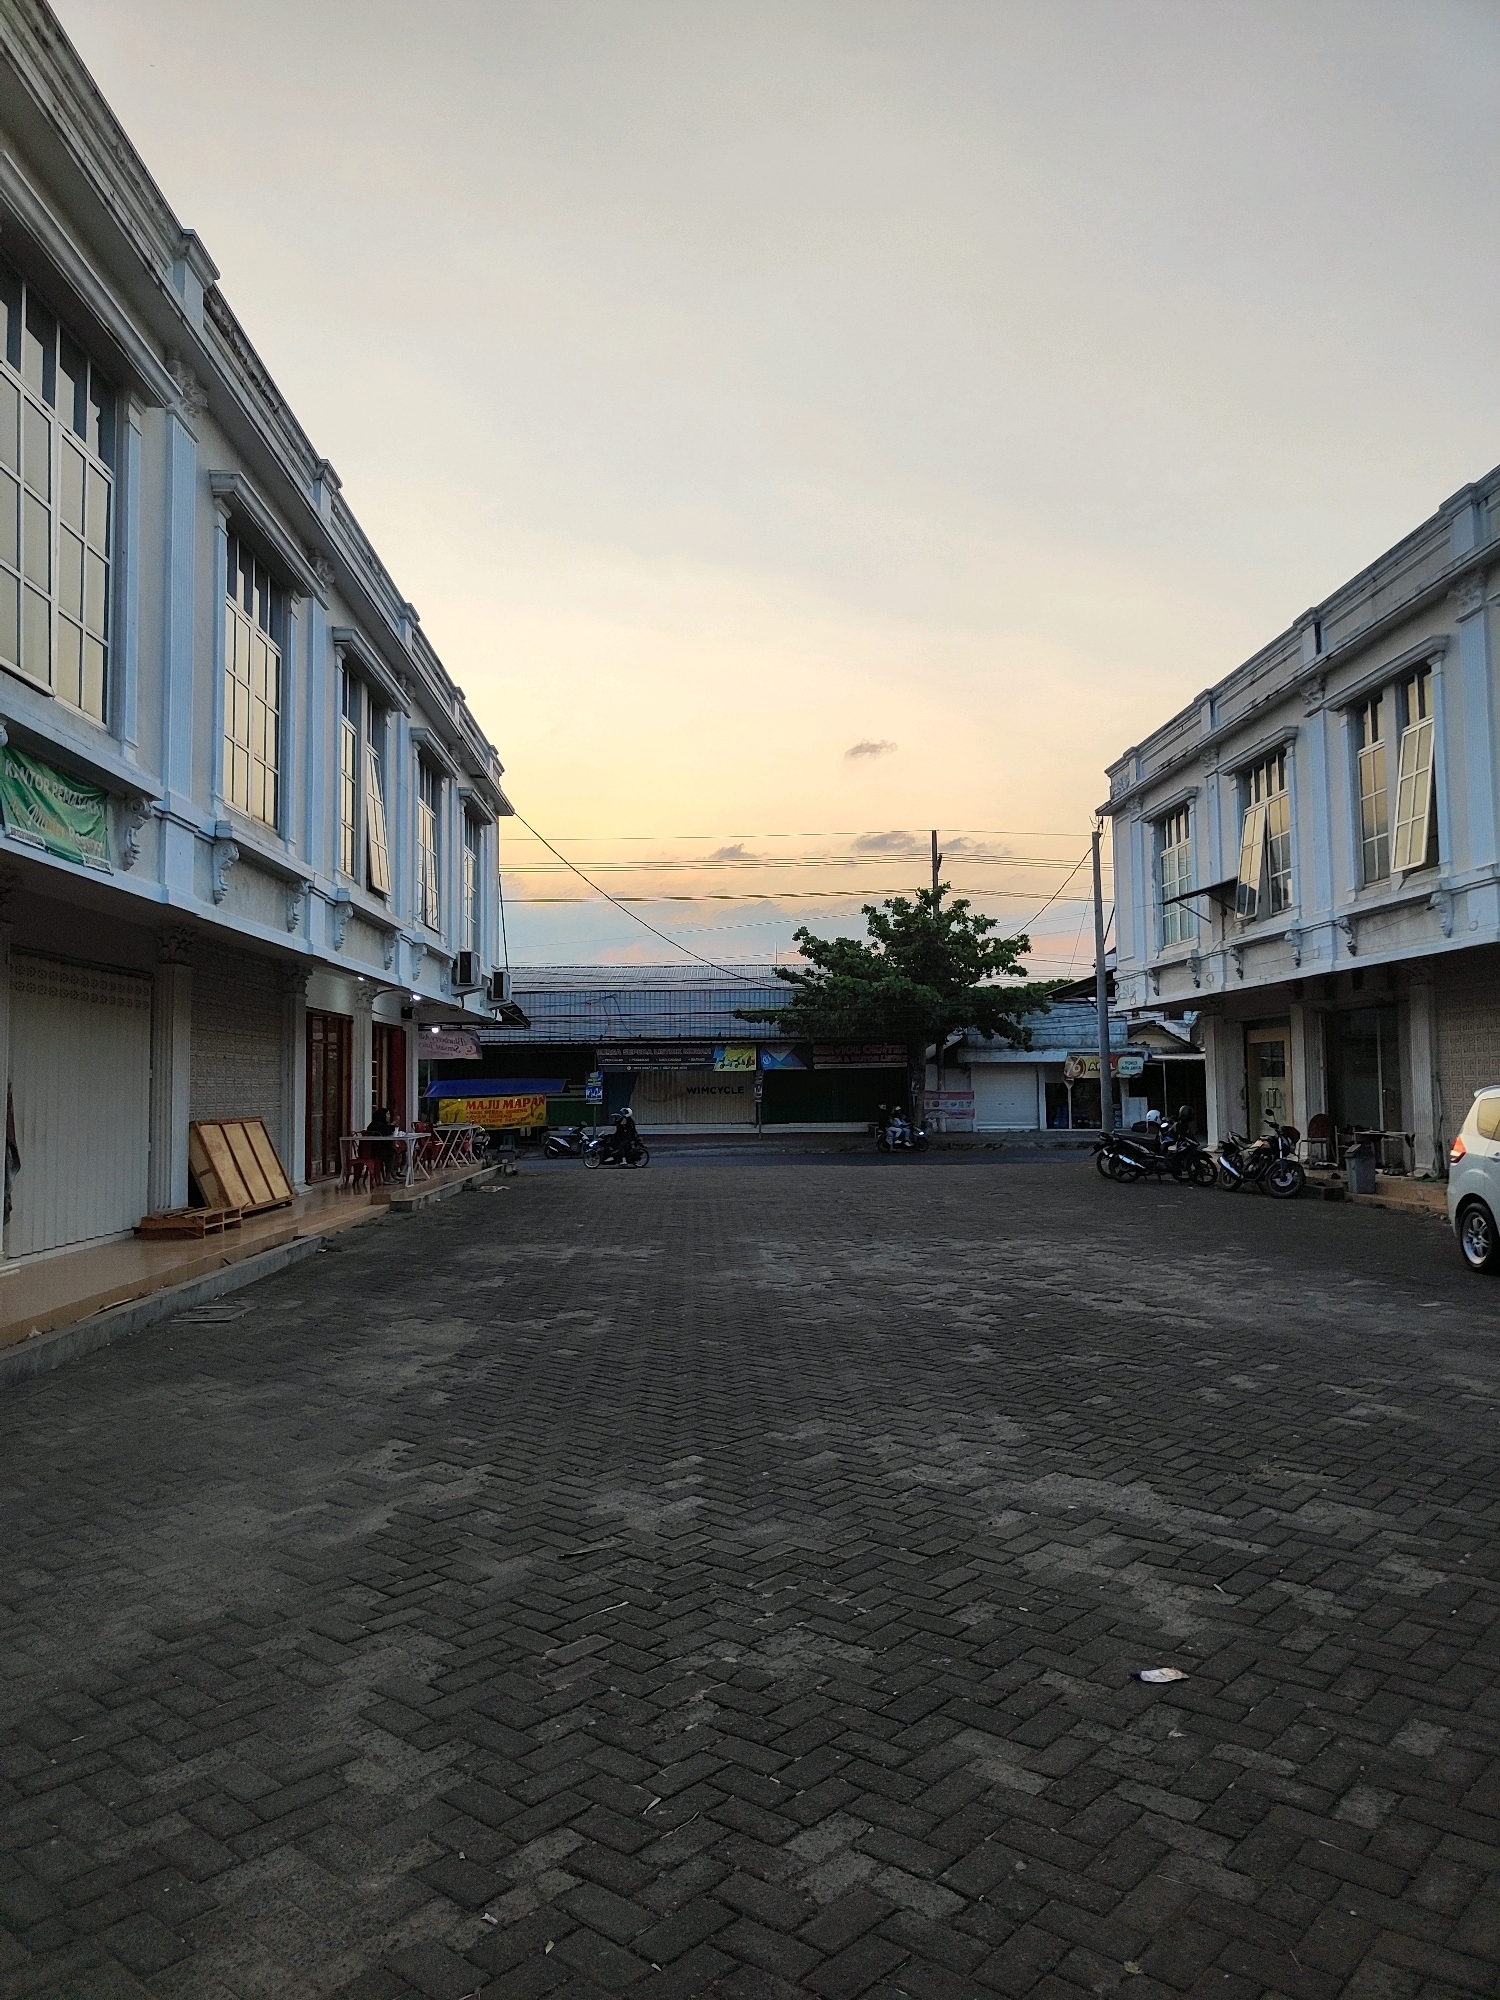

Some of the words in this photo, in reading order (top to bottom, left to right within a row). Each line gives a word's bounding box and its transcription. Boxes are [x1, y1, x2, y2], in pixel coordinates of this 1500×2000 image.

[4, 758, 51, 797] KANTOR
[622, 1048, 653, 1056] SEPEDA
[813, 1044, 862, 1055] SERVICE
[863, 1044, 908, 1054] CENTER
[1087, 1062, 1116, 1071] APL
[686, 1086, 745, 1095] WIMCYCLE
[465, 1099, 500, 1110] MAJU
[502, 1096, 545, 1110] MAPAN
